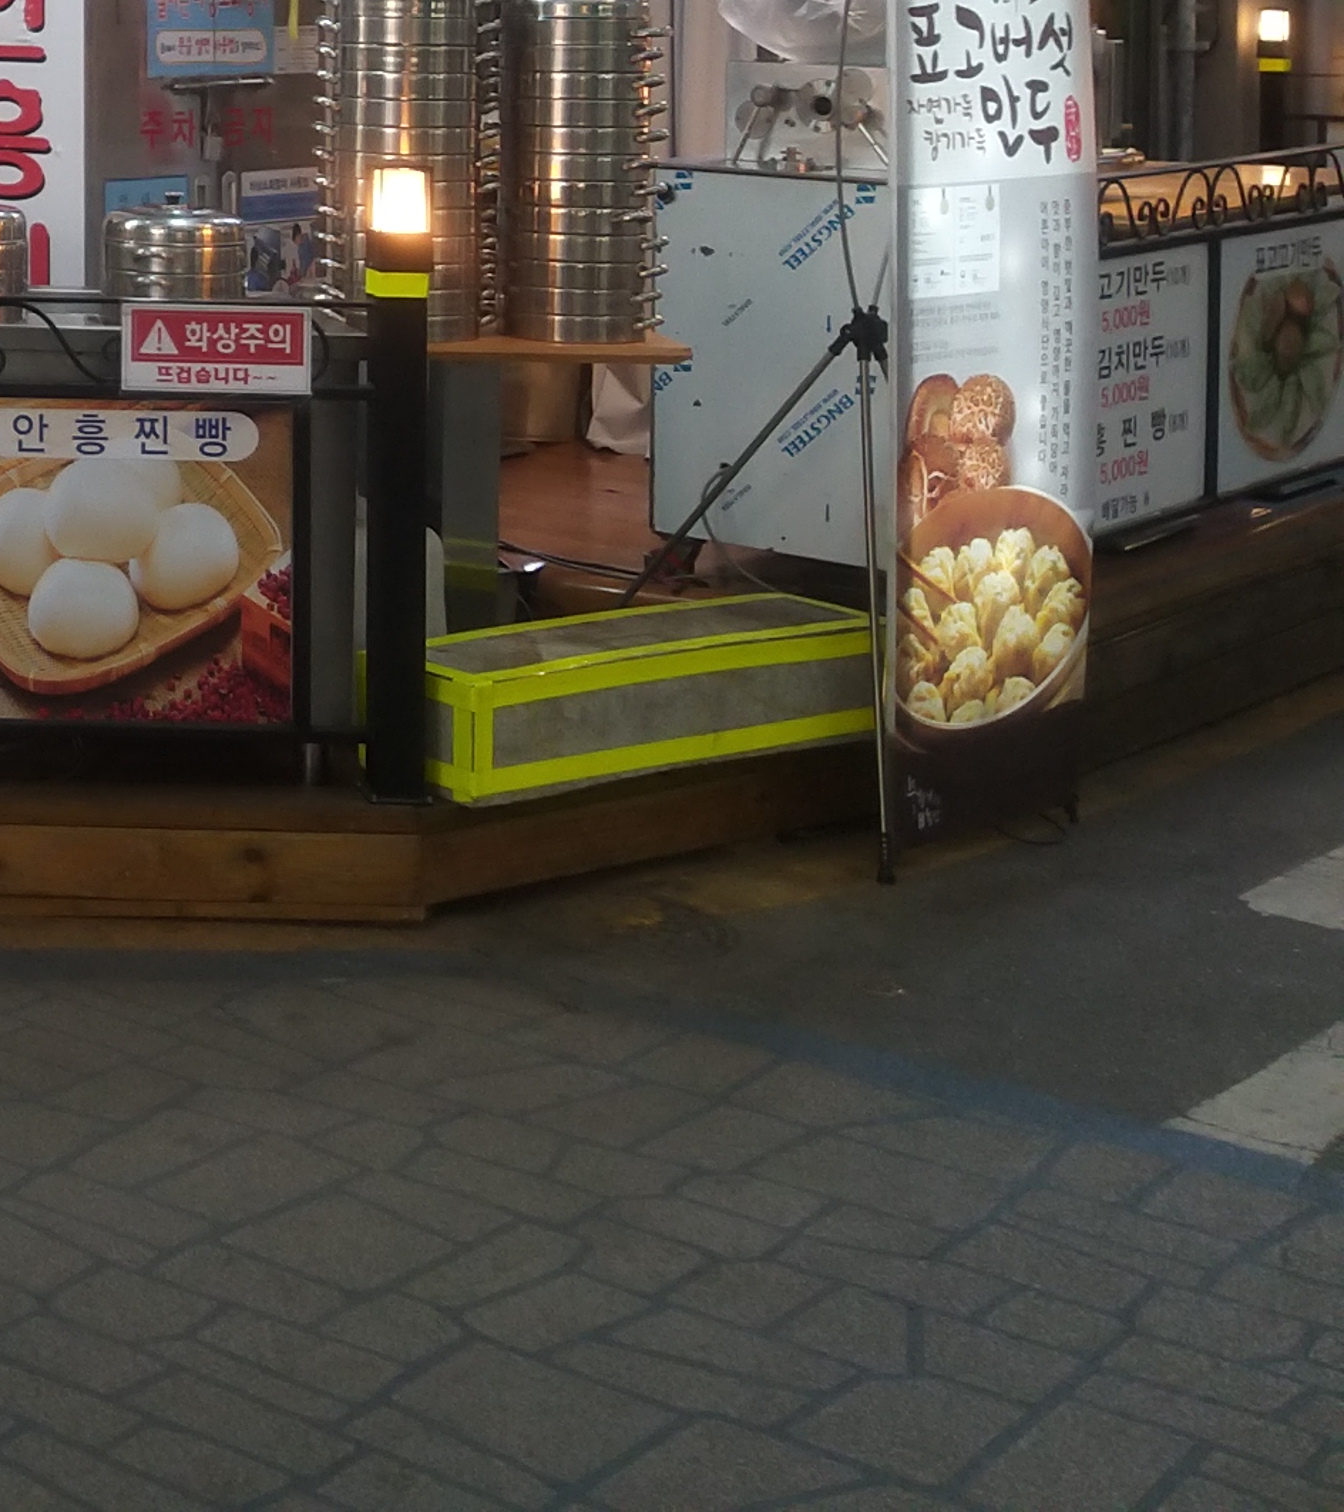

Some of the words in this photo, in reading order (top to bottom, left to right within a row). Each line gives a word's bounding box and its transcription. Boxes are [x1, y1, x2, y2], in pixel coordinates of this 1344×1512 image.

[908, 3, 1073, 85] 표고버섯
[980, 75, 1060, 164] 만두
[1255, 235, 1323, 274] 표고고기만두
[185, 320, 292, 354] 화상주의
